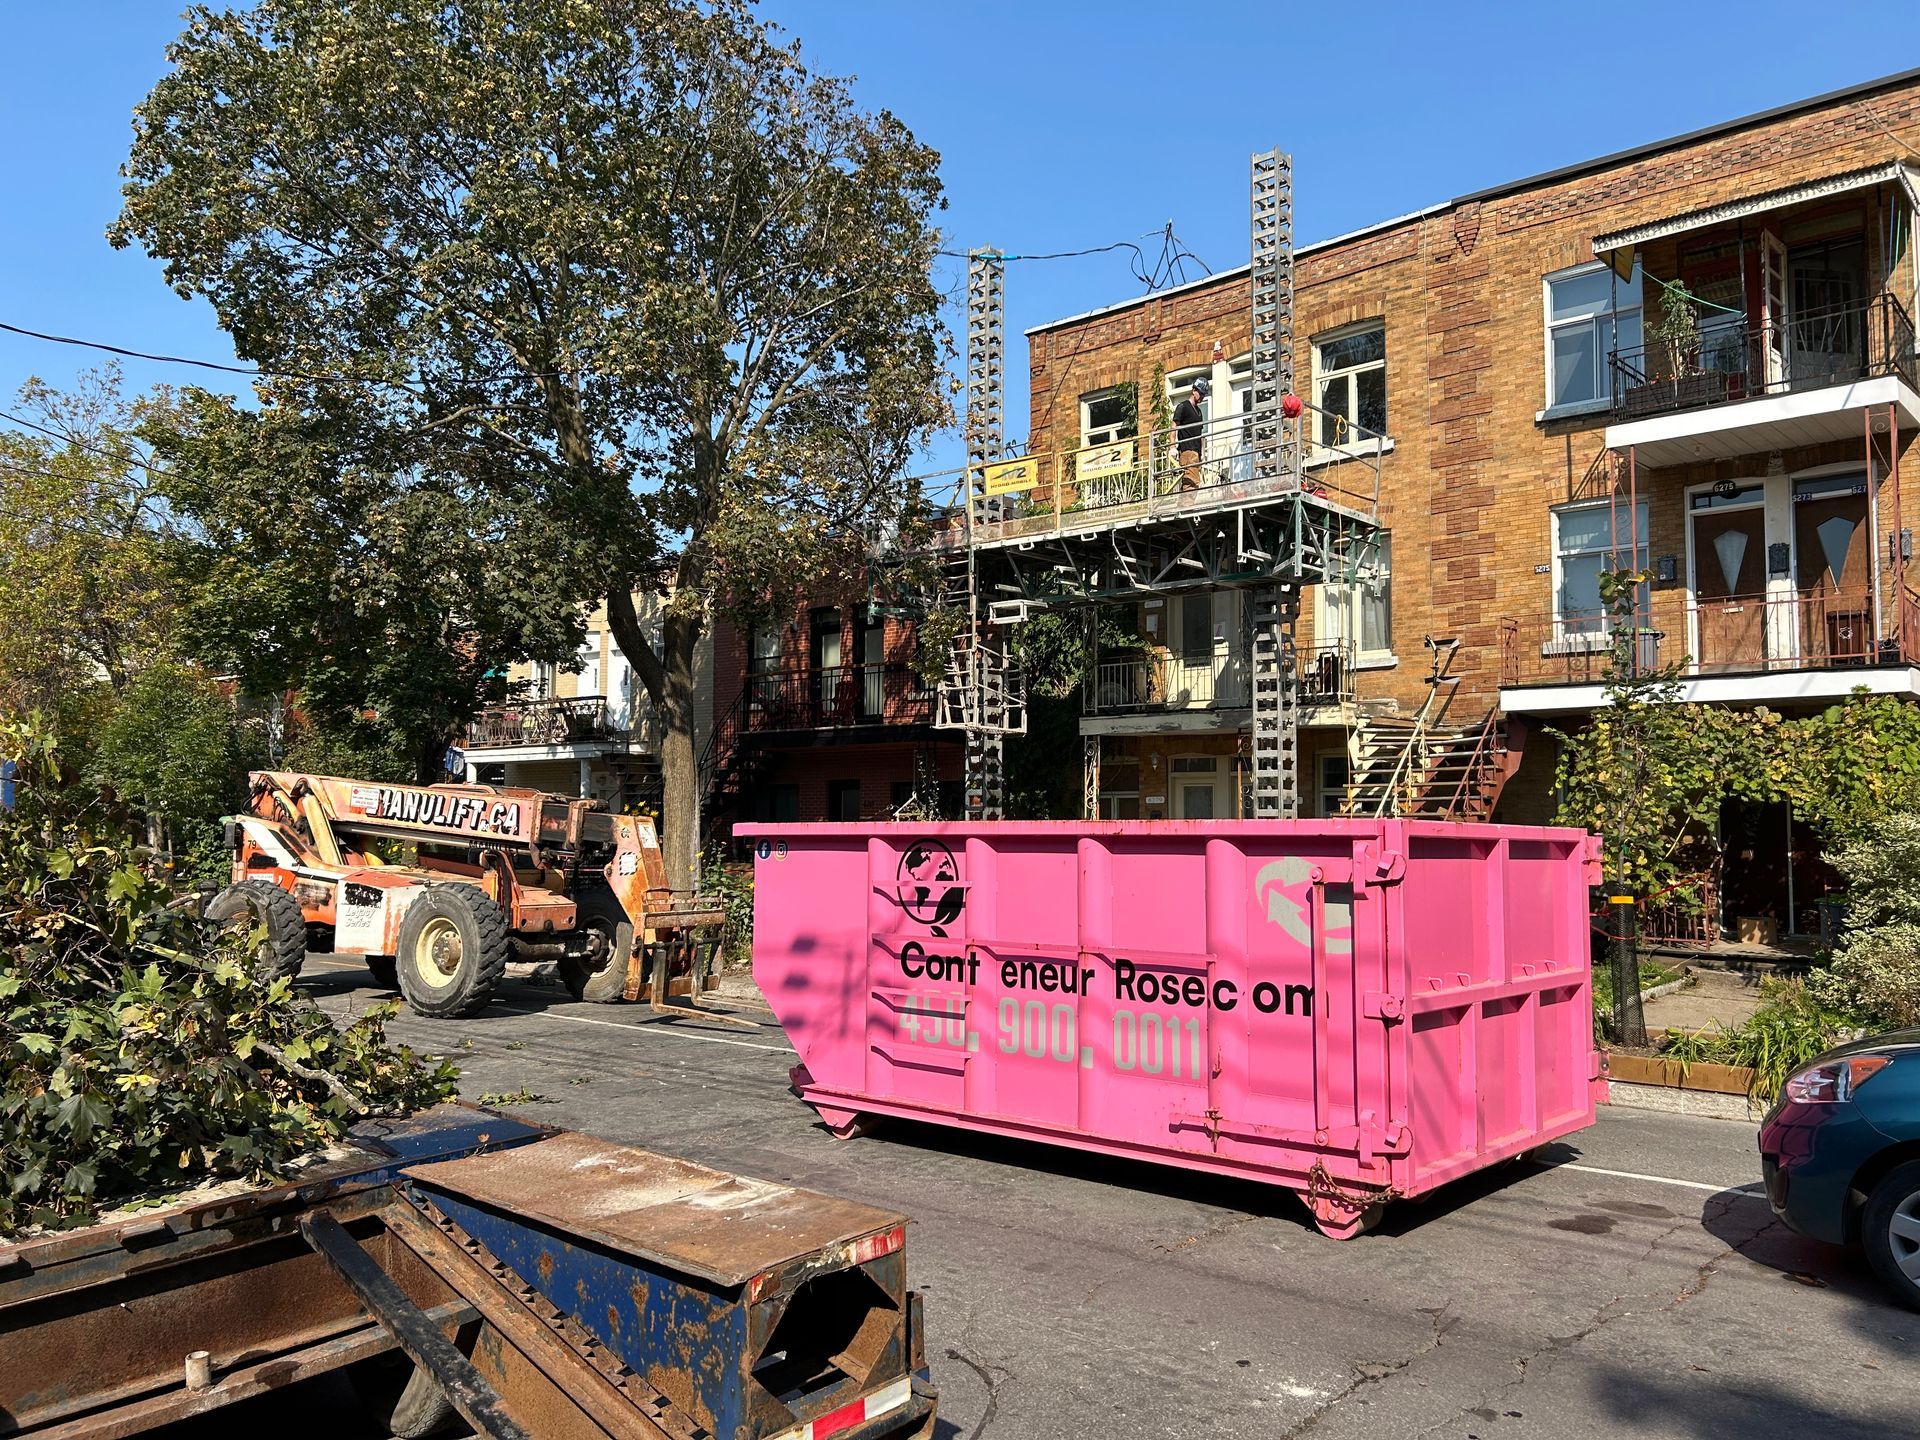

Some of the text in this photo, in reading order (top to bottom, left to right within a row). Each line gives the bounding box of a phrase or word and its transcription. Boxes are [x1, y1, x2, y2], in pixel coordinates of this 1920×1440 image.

[1714, 482, 1734, 492] 6275
[1852, 485, 1868, 494] 627
[247, 839, 257, 849] 79
[345, 906, 376, 919] Legacy
[345, 917, 372, 928] Series
